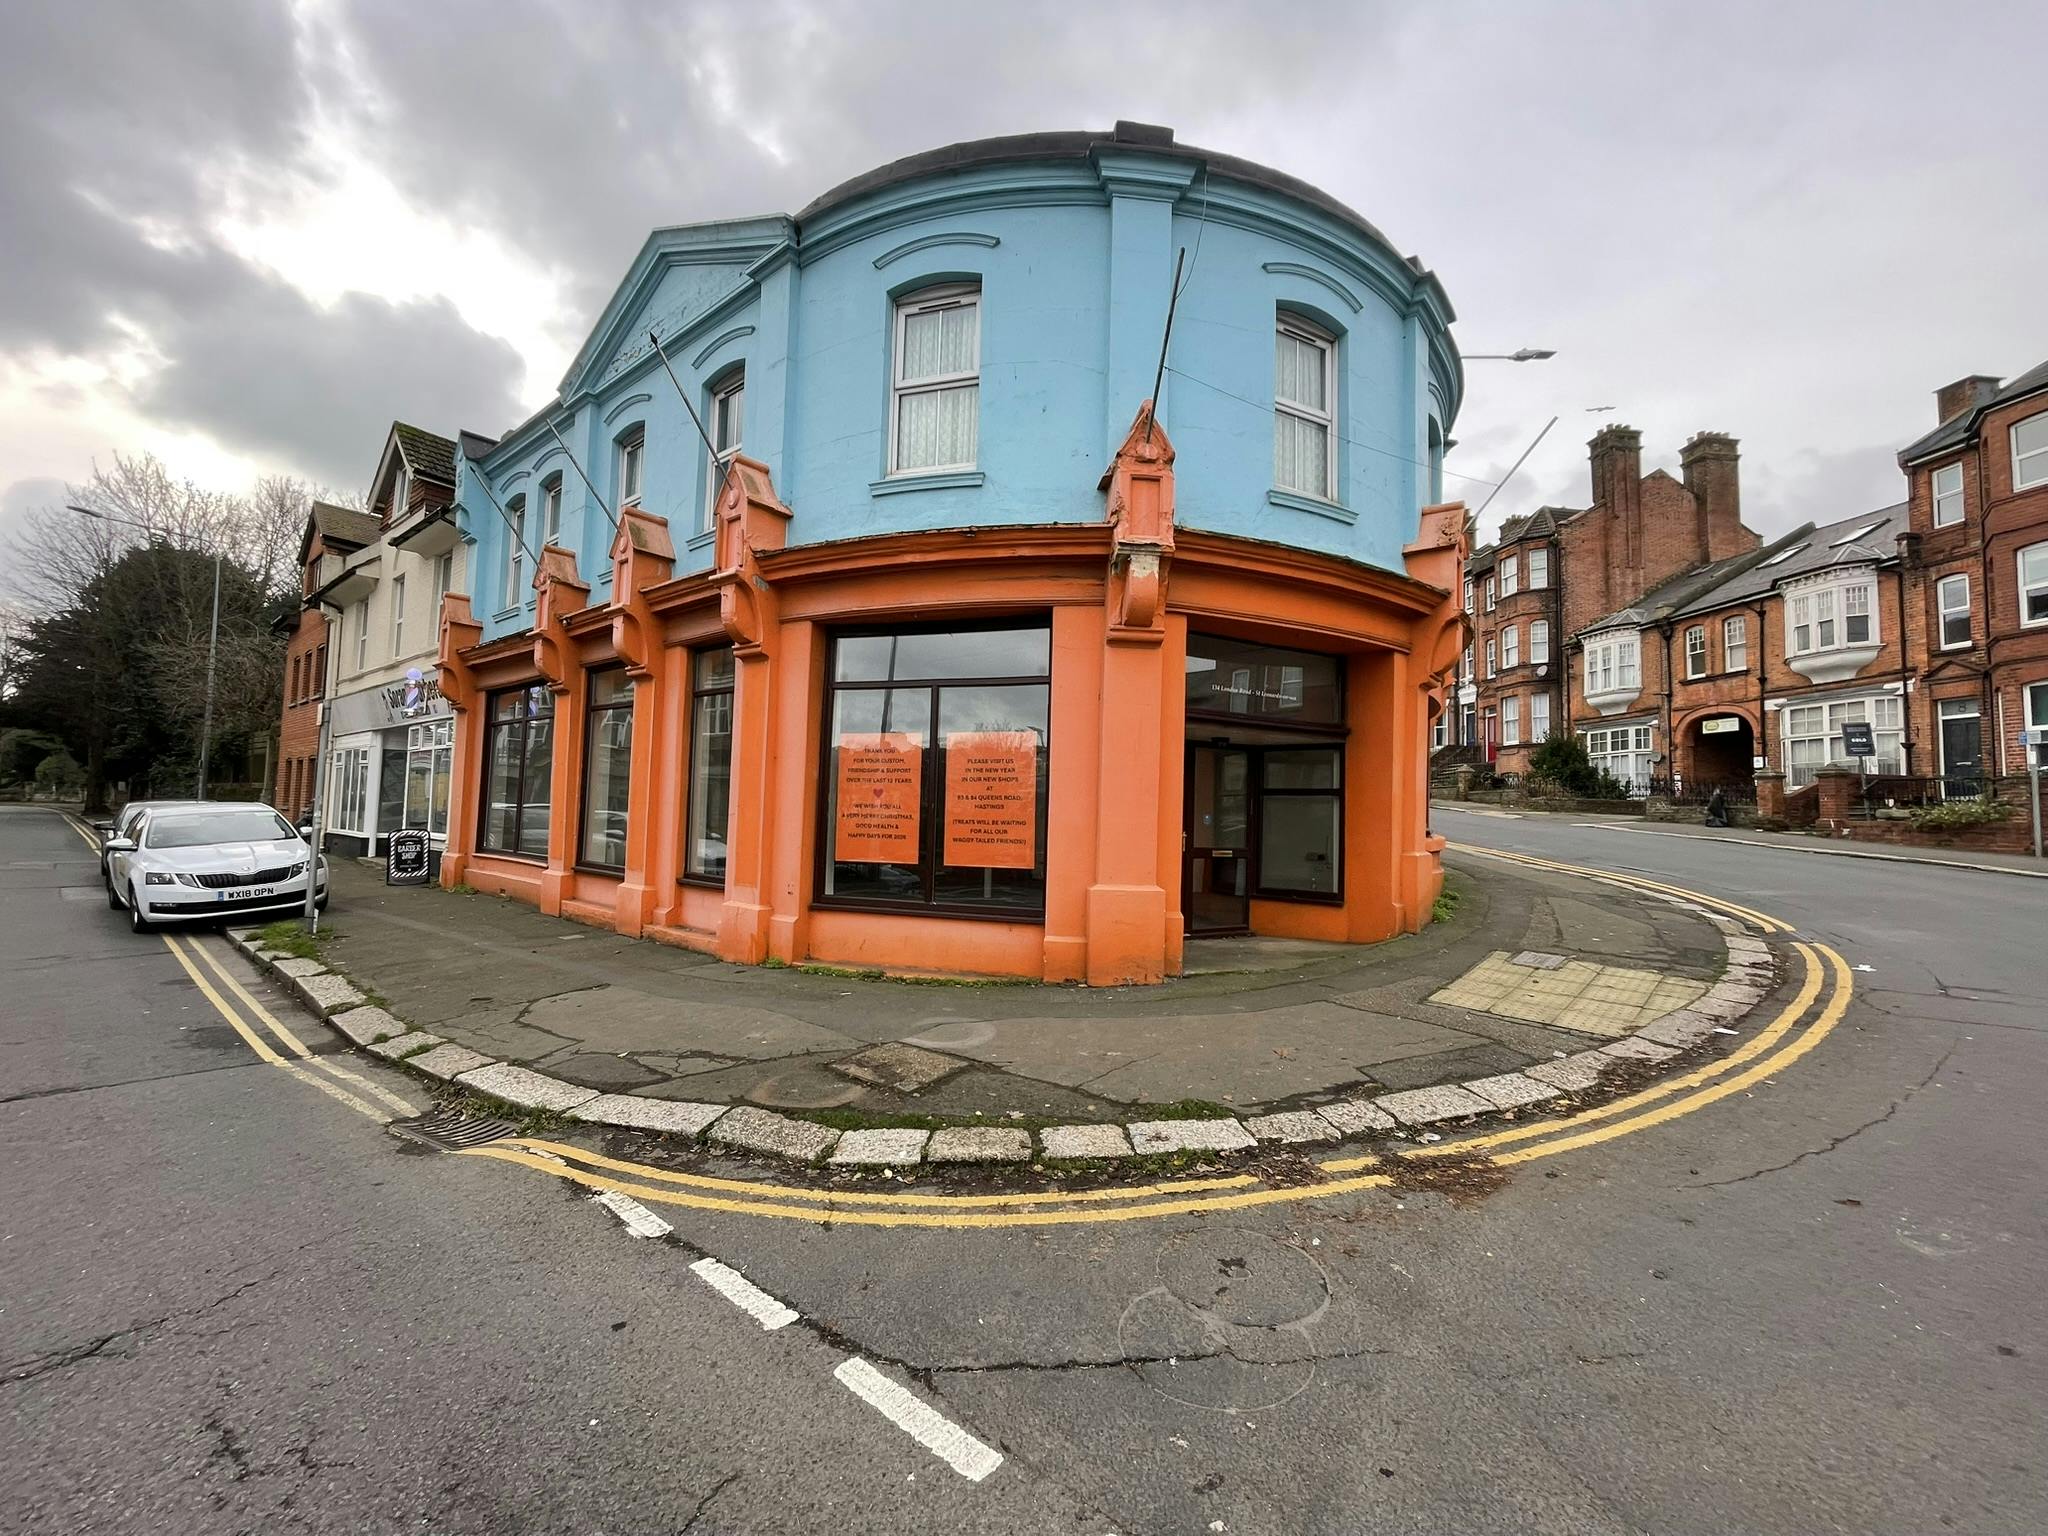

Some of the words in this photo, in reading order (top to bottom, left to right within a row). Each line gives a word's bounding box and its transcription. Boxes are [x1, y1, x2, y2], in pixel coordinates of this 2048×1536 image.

[1221, 685, 1238, 693] London
[1239, 687, 1252, 695] Road
[1959, 702, 1966, 712] 8
[397, 844, 422, 853] BARBER
[401, 852, 417, 860] SHOP
[228, 890, 252, 899] WX18
[254, 887, 274, 896] OPN
